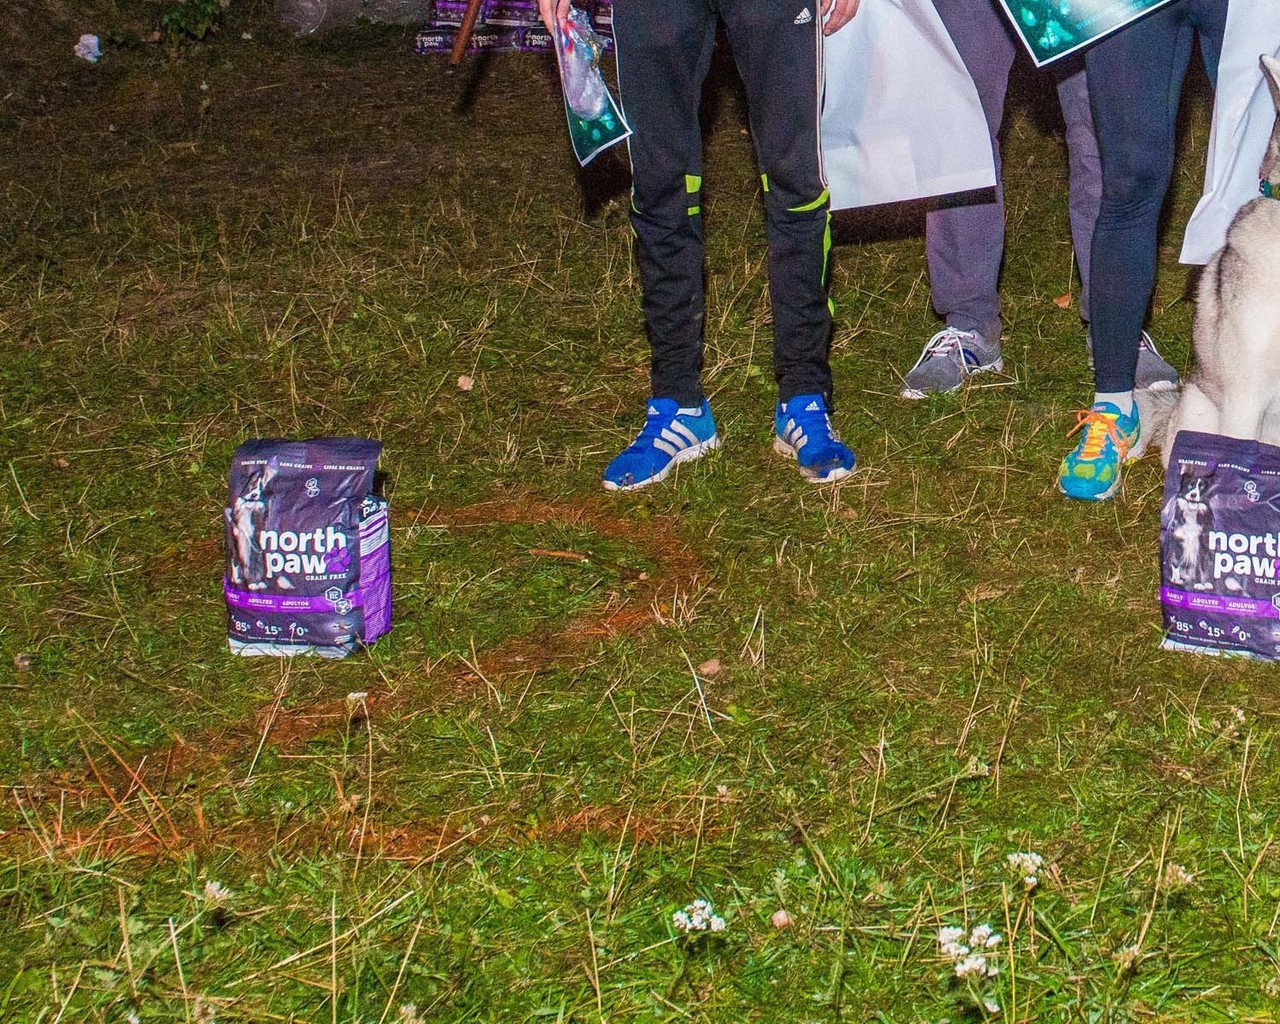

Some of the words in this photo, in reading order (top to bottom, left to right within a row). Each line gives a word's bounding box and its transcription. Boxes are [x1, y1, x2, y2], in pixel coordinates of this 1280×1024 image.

[260, 527, 347, 553] north
[266, 551, 327, 578] paw
[1213, 551, 1276, 578] paw
[1254, 577, 1276, 585] GRAIN
